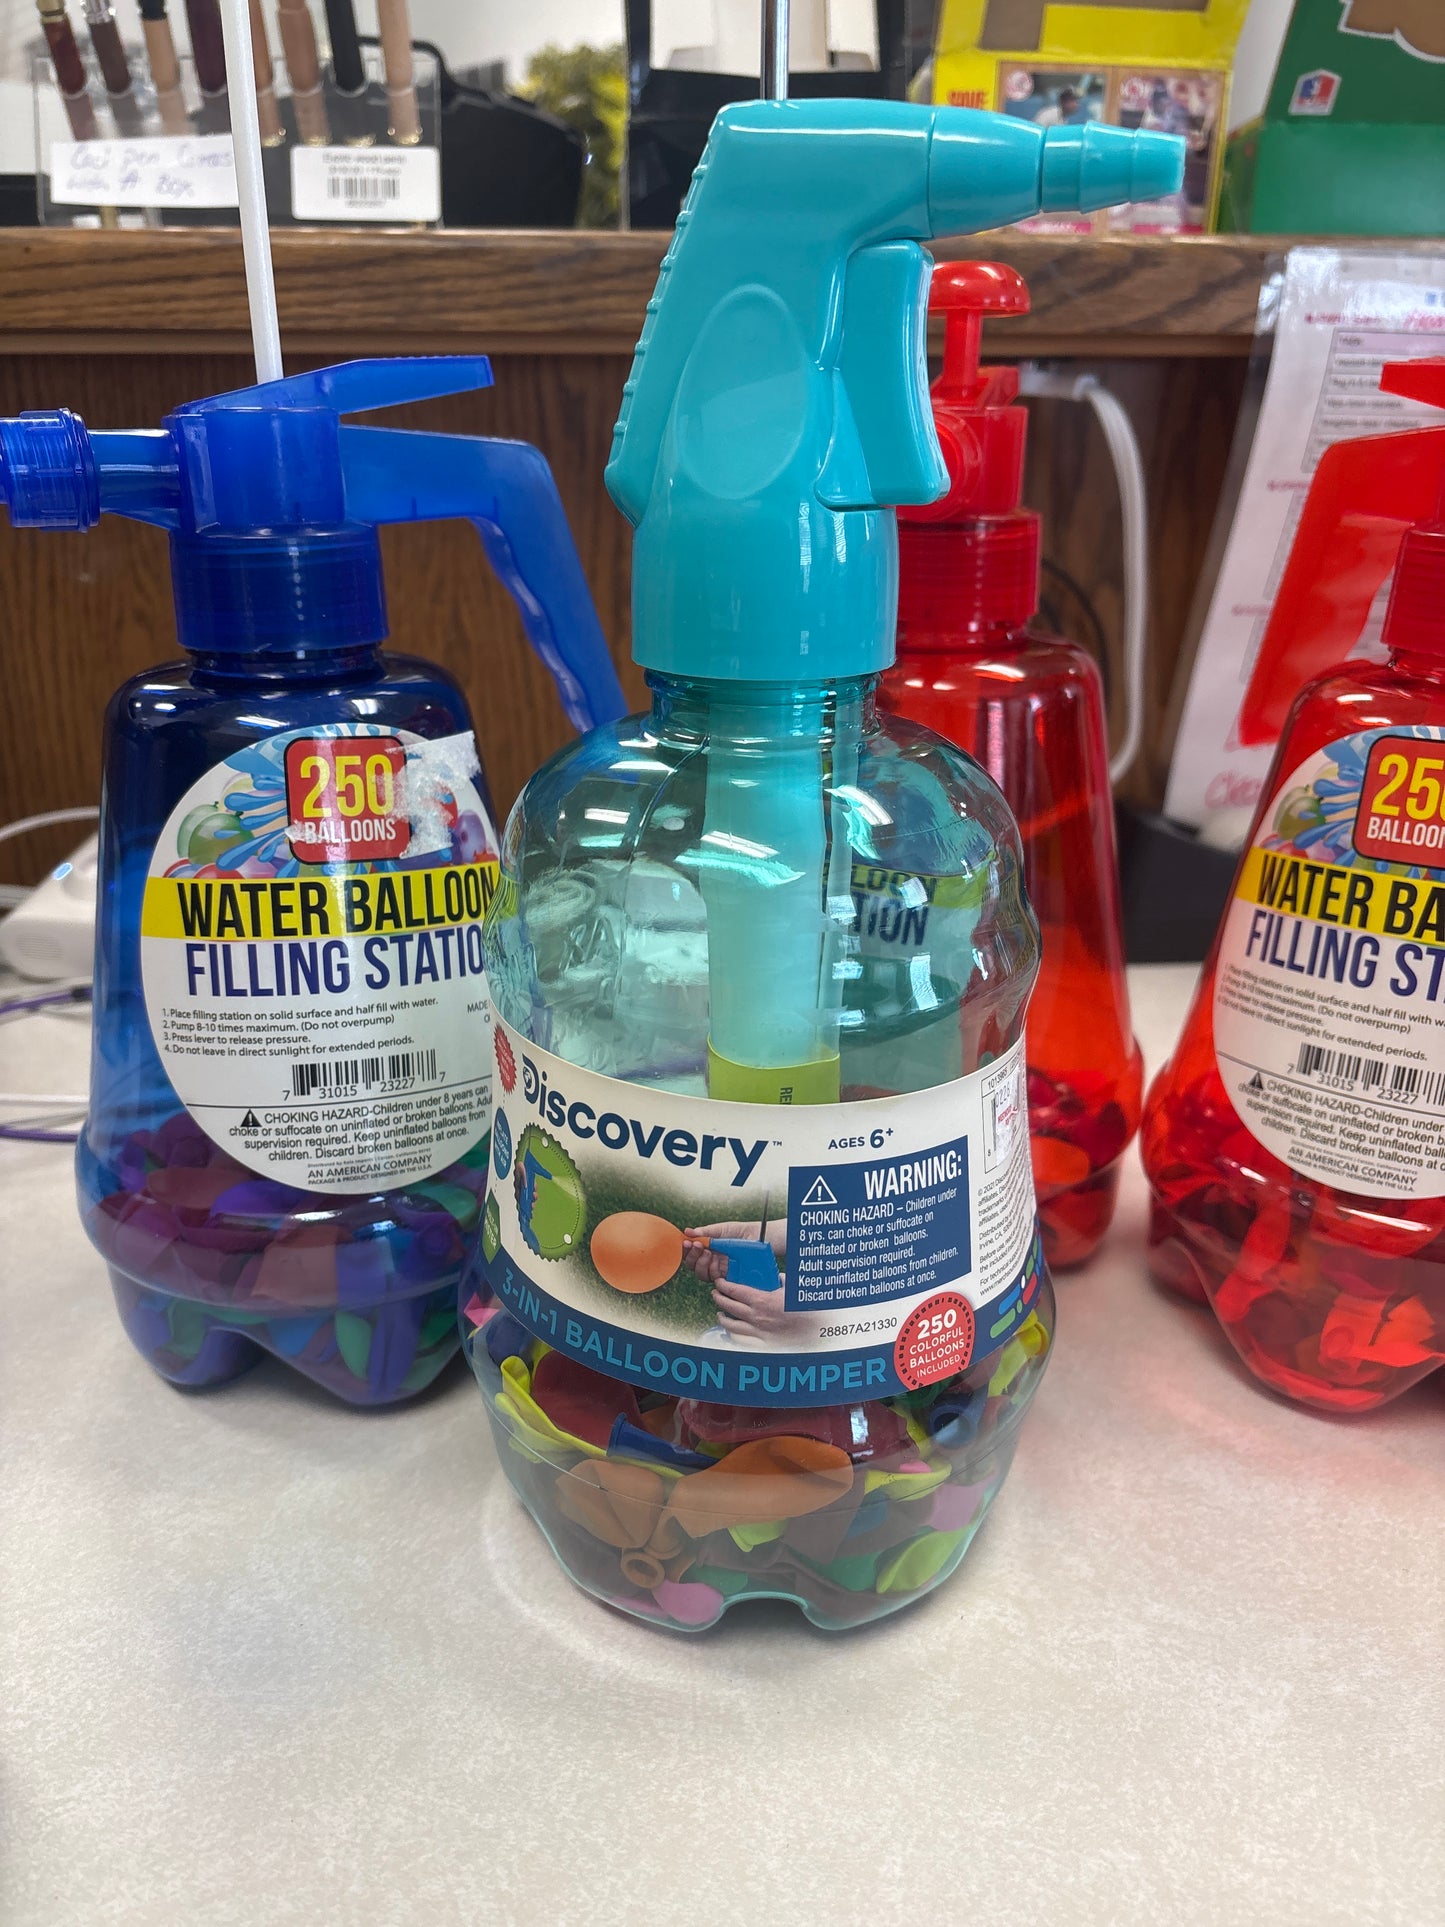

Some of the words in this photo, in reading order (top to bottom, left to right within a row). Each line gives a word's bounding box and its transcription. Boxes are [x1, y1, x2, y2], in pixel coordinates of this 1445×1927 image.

[300, 754, 394, 818] 250
[1370, 753, 1445, 821] 25
[304, 818, 396, 845] BALLOONS
[1366, 816, 1445, 850] BALLOO
[177, 880, 330, 938] WATER
[347, 864, 495, 933] BALLOON
[1257, 854, 1375, 930] WATER
[185, 939, 351, 998] FILLING
[364, 924, 486, 989] STATIO
[1245, 908, 1380, 989] FILLING
[170, 1008, 192, 1019] Place
[193, 1010, 218, 1022] filling
[219, 1012, 251, 1021] station
[254, 1012, 267, 1021] on
[270, 1010, 294, 1020] solid
[296, 1008, 332, 1020] surface
[334, 1004, 354, 1016] and
[356, 1002, 374, 1015] half
[376, 1001, 388, 1012] fill
[390, 998, 410, 1012] with
[412, 996, 438, 1009] water.
[171, 1020, 195, 1032] Pump
[196, 1022, 216, 1032] 8-10
[218, 1022, 244, 1033] times
[246, 1022, 298, 1033] maximum.
[300, 1020, 319, 1032] (Do
[322, 1020, 339, 1030] not
[341, 1014, 395, 1030] overpump)
[467, 1000, 488, 1014] MADE
[1317, 993, 1350, 1009] surface
[1350, 1002, 1370, 1014] and
[1372, 1004, 1392, 1018] half
[1394, 1008, 1407, 1020] fill
[1408, 1013, 1432, 1026] with
[1318, 1004, 1334, 1018] (Do
[1336, 1010, 1353, 1022] not
[1354, 1014, 1412, 1035] overpump)
[172, 1032, 193, 1043] Press
[194, 1034, 216, 1044] lever
[218, 1035, 228, 1045] to
[230, 1034, 263, 1045] release
[266, 1034, 311, 1046] pressure.
[172, 1045, 185, 1054] Do
[186, 1046, 200, 1055] not
[202, 1046, 226, 1056] leave
[228, 1046, 236, 1056] in
[238, 1046, 267, 1056] direct
[269, 1044, 310, 1058] sunlight
[312, 1044, 326, 1054] for
[328, 1040, 376, 1053] extended
[378, 1036, 415, 1050] periods.
[1322, 1030, 1336, 1041] for
[1336, 1034, 1384, 1053] extended
[1385, 1046, 1428, 1062] periods.
[282, 1090, 290, 1101] 7
[318, 1088, 358, 1100] 31015
[380, 1077, 416, 1093] 23227
[438, 1072, 446, 1083] 7
[779, 1086, 794, 1104] RE
[1317, 1072, 1355, 1092] 31015
[1376, 1086, 1419, 1105] 23227
[228, 1126, 259, 1136] choke
[262, 1128, 272, 1136] or
[274, 1124, 322, 1136] suffocate
[324, 1124, 338, 1133] on
[341, 1116, 390, 1131] uninflated
[392, 1115, 404, 1126] or
[406, 1110, 438, 1124] broken
[439, 1102, 475, 1117] balloons.
[476, 1094, 492, 1108] Adul
[264, 1110, 318, 1124] CHOKING
[322, 1101, 414, 1122] HAZARD-Children
[416, 1096, 441, 1110] under
[444, 1092, 450, 1104] 8
[452, 1090, 474, 1104] years
[474, 1085, 488, 1096] can
[522, 1053, 769, 1187] Discovery
[1266, 1080, 1312, 1104] CHOKING
[1412, 1119, 1444, 1133] under
[244, 1138, 302, 1152] supervision
[305, 1134, 352, 1148] required.
[354, 1130, 380, 1144] Keep
[383, 1124, 430, 1140] uninflated
[432, 1116, 468, 1131] balloons
[468, 1110, 486, 1122] from
[268, 1150, 312, 1162] children.
[315, 1146, 355, 1160] Discard
[358, 1138, 392, 1154] broken
[394, 1133, 434, 1148] balloons
[436, 1131, 445, 1142] at
[446, 1126, 470, 1140] once.
[828, 1136, 866, 1150] AGES
[869, 1128, 894, 1149] 6+
[1328, 1112, 1380, 1133] uninflated
[1396, 1128, 1434, 1144] broken
[1338, 1126, 1367, 1145] Keep
[1368, 1135, 1422, 1154] uninflated
[1300, 1126, 1338, 1147] Discard
[1338, 1140, 1376, 1158] broken
[1378, 1148, 1424, 1168] balloons
[308, 1170, 324, 1178] AN
[326, 1164, 381, 1177] AMERICAN
[383, 1154, 433, 1170] COMPANY
[864, 1150, 962, 1200] WARNING:
[1305, 1150, 1359, 1174] AMERICAN
[1360, 1166, 1418, 1186] COMPANY
[800, 1208, 850, 1226] CHOKING
[852, 1202, 894, 1222] HAZARD
[905, 1196, 936, 1212] Children
[937, 1187, 958, 1204] under
[799, 1242, 846, 1256] uninflated
[847, 1242, 858, 1253] or
[859, 1236, 890, 1252] broken
[893, 1229, 928, 1246] balloons.
[800, 1230, 806, 1242] 8
[808, 1232, 826, 1244] yrs.
[828, 1229, 845, 1240] can
[846, 1224, 874, 1240] choke
[875, 1224, 886, 1235] or
[886, 1214, 923, 1232] suffocate
[924, 1210, 934, 1222] on
[798, 1257, 823, 1272] Adult
[826, 1252, 877, 1270] supervision
[879, 1245, 916, 1265] required.
[798, 1272, 822, 1289] Keep
[824, 1267, 870, 1286] uninflated
[872, 1260, 908, 1280] balloons
[909, 1256, 928, 1272] from
[928, 1246, 959, 1266] children.
[798, 1286, 834, 1302] Discard
[836, 1282, 868, 1298] broken
[869, 1274, 906, 1294] balloons
[906, 1274, 916, 1286] at
[916, 1268, 937, 1284] once.
[501, 1267, 558, 1336] 3-IN-1
[564, 1319, 725, 1390] BALLOON
[738, 1357, 888, 1394] PUMPER
[819, 1316, 898, 1339] 28887A21330
[909, 1326, 964, 1355] COLORFUL
[917, 1308, 957, 1340] 250
[910, 1338, 965, 1369] BALLOONS
[916, 1354, 961, 1378] INCLUDED
